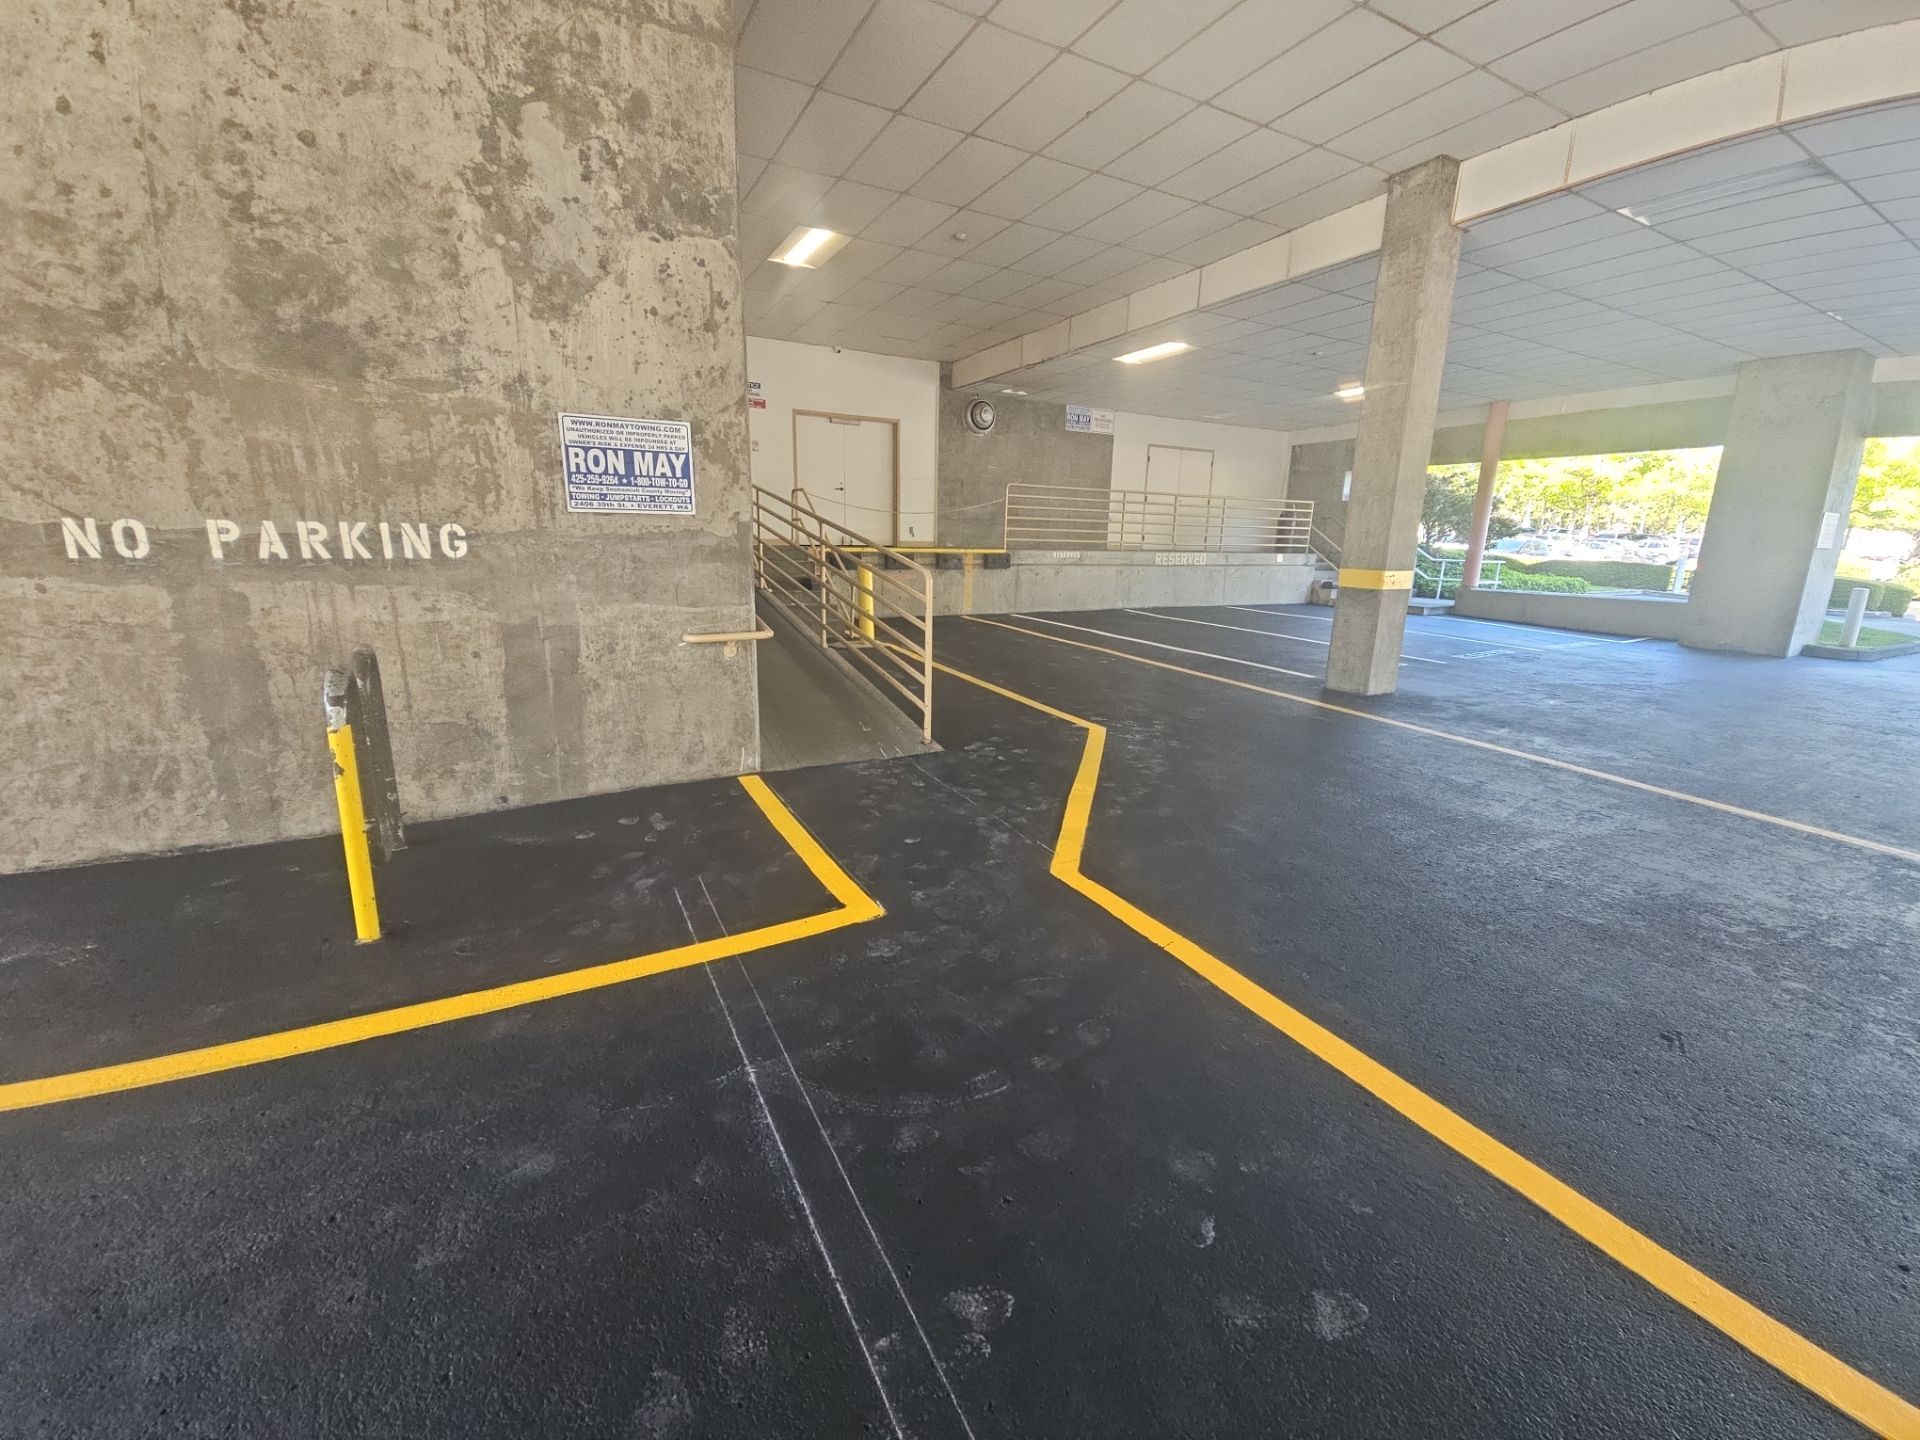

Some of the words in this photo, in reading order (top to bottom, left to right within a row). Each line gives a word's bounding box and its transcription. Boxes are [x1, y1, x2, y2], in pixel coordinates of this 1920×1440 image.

[566, 427, 614, 435] UNAUTHORIZED
[571, 419, 681, 433] WWW.RONMAYTOWING.COM
[568, 447, 625, 474] RON
[632, 451, 687, 477] MAY
[571, 473, 619, 485] 425-259-9264
[571, 492, 600, 500] TOWING
[605, 493, 650, 502] JUMPSTARTS
[655, 496, 691, 504] LOCKOUTS
[60, 516, 150, 560] NO
[205, 519, 468, 561] PARKING
[1155, 552, 1207, 566] RESERVED
